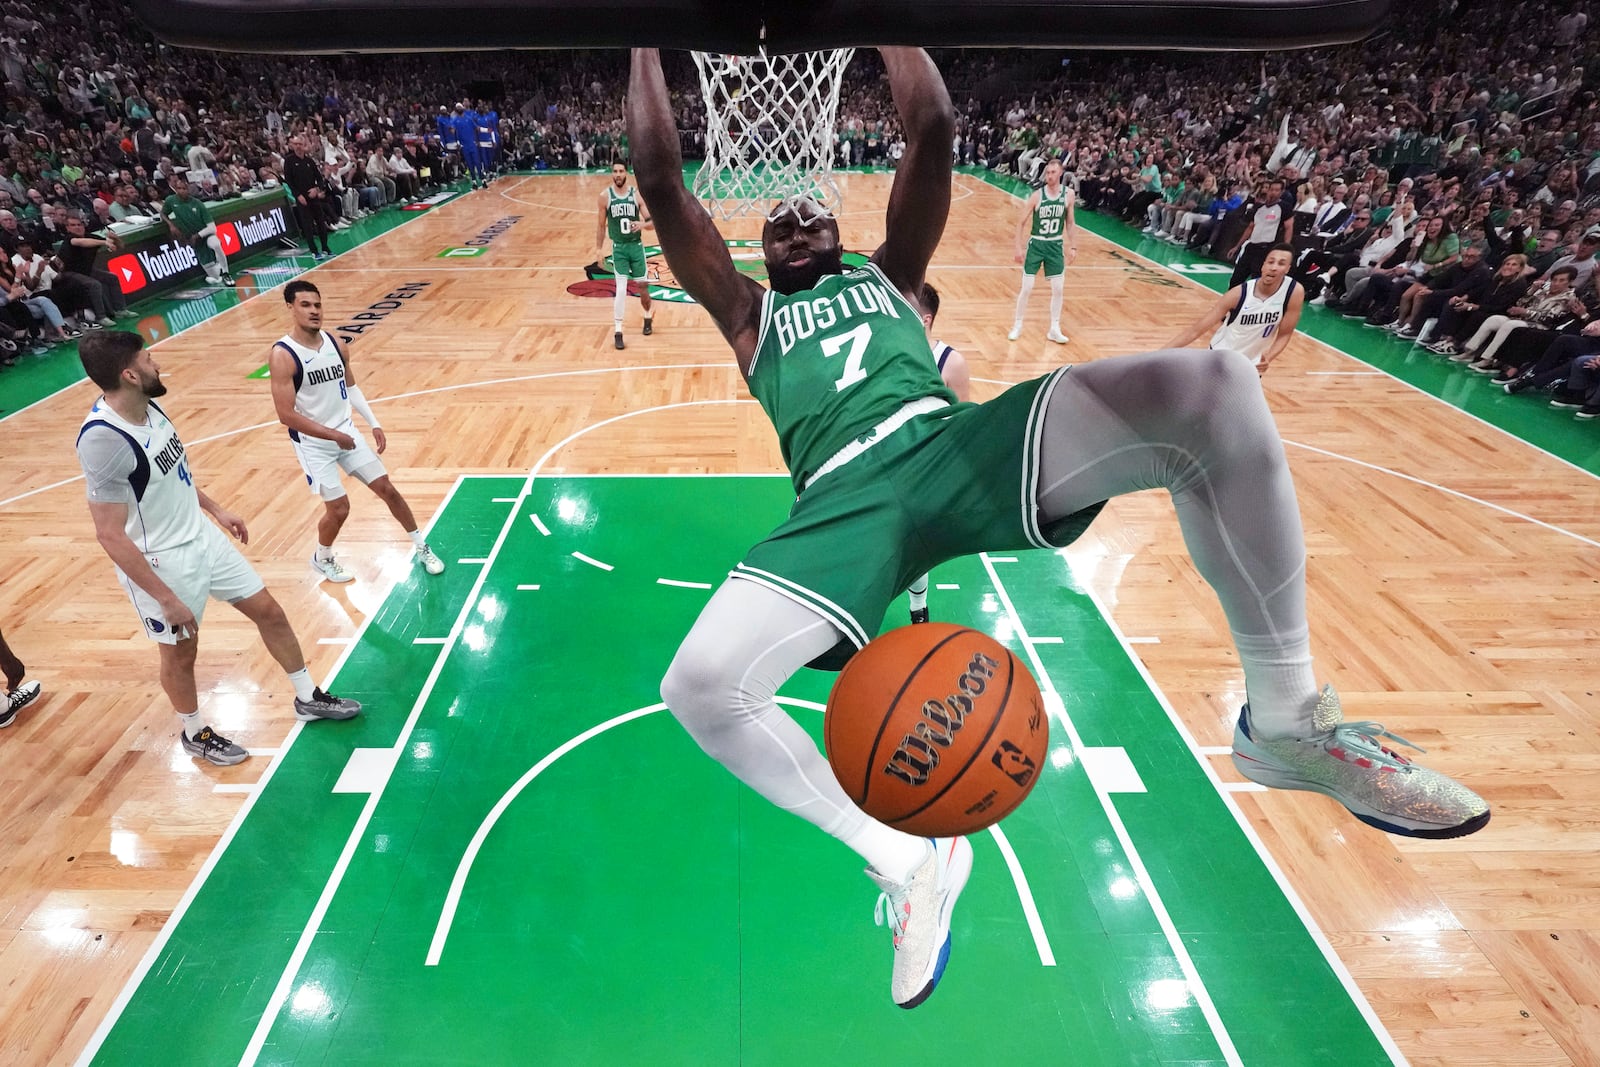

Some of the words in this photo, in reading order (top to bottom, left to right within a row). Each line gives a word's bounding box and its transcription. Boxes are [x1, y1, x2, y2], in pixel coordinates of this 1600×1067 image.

[610, 203, 636, 218] BOSTON
[1039, 204, 1066, 219] BOSTON
[465, 214, 525, 247] GARDEN
[620, 217, 631, 234] 0
[1039, 218, 1060, 235] 30
[137, 239, 199, 282] YouTube
[773, 281, 901, 357] BOSTON
[1240, 311, 1280, 326] DALLAS
[1261, 324, 1275, 338] 0
[819, 322, 873, 393] 7
[307, 364, 344, 386] DALLAS
[338, 379, 348, 400] 8
[154, 432, 184, 476] DALLAS
[884, 652, 1000, 787] Wilson
